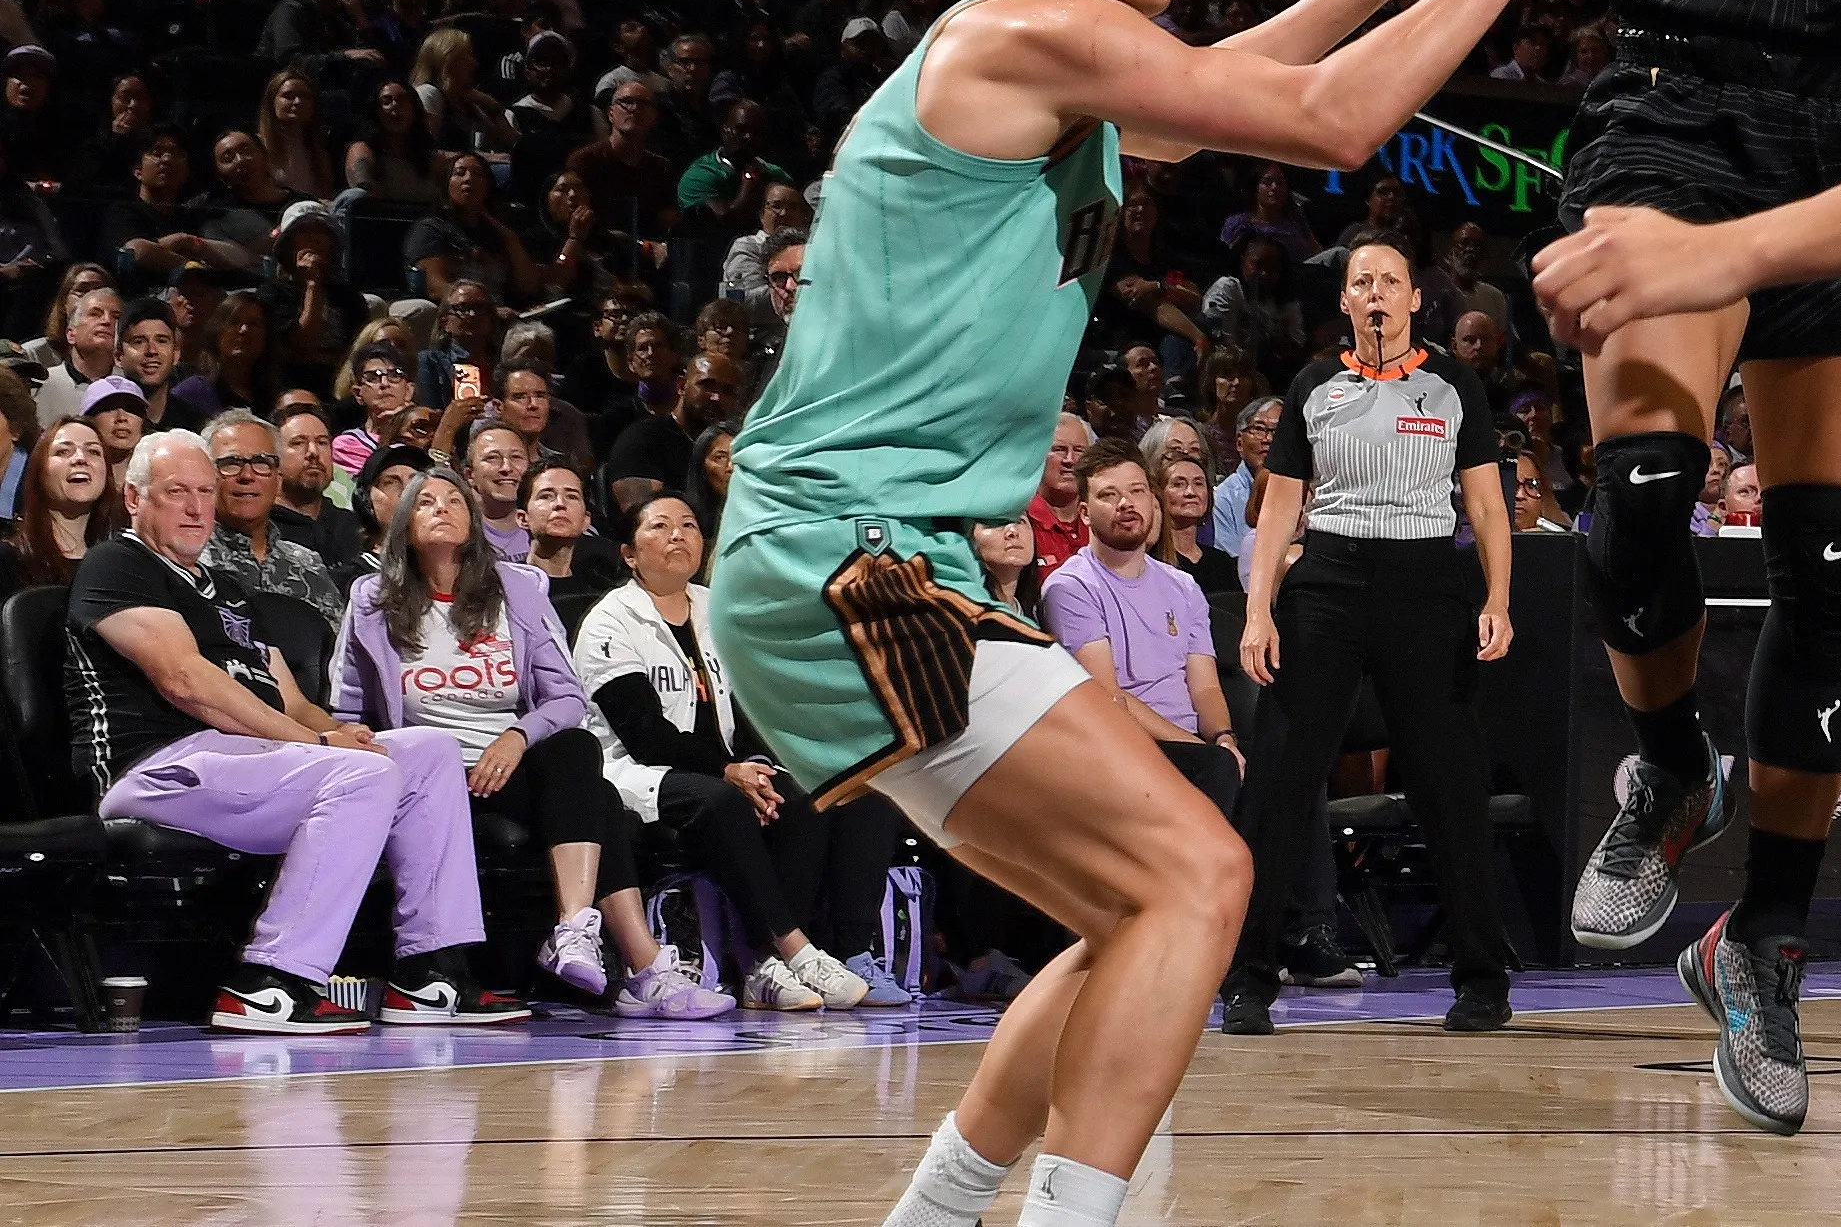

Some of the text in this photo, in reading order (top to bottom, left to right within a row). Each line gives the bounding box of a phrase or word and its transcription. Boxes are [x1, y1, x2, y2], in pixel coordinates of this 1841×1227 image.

[1397, 420, 1445, 434] Emirates
[402, 658, 517, 696] roots
[420, 690, 504, 705] canada
